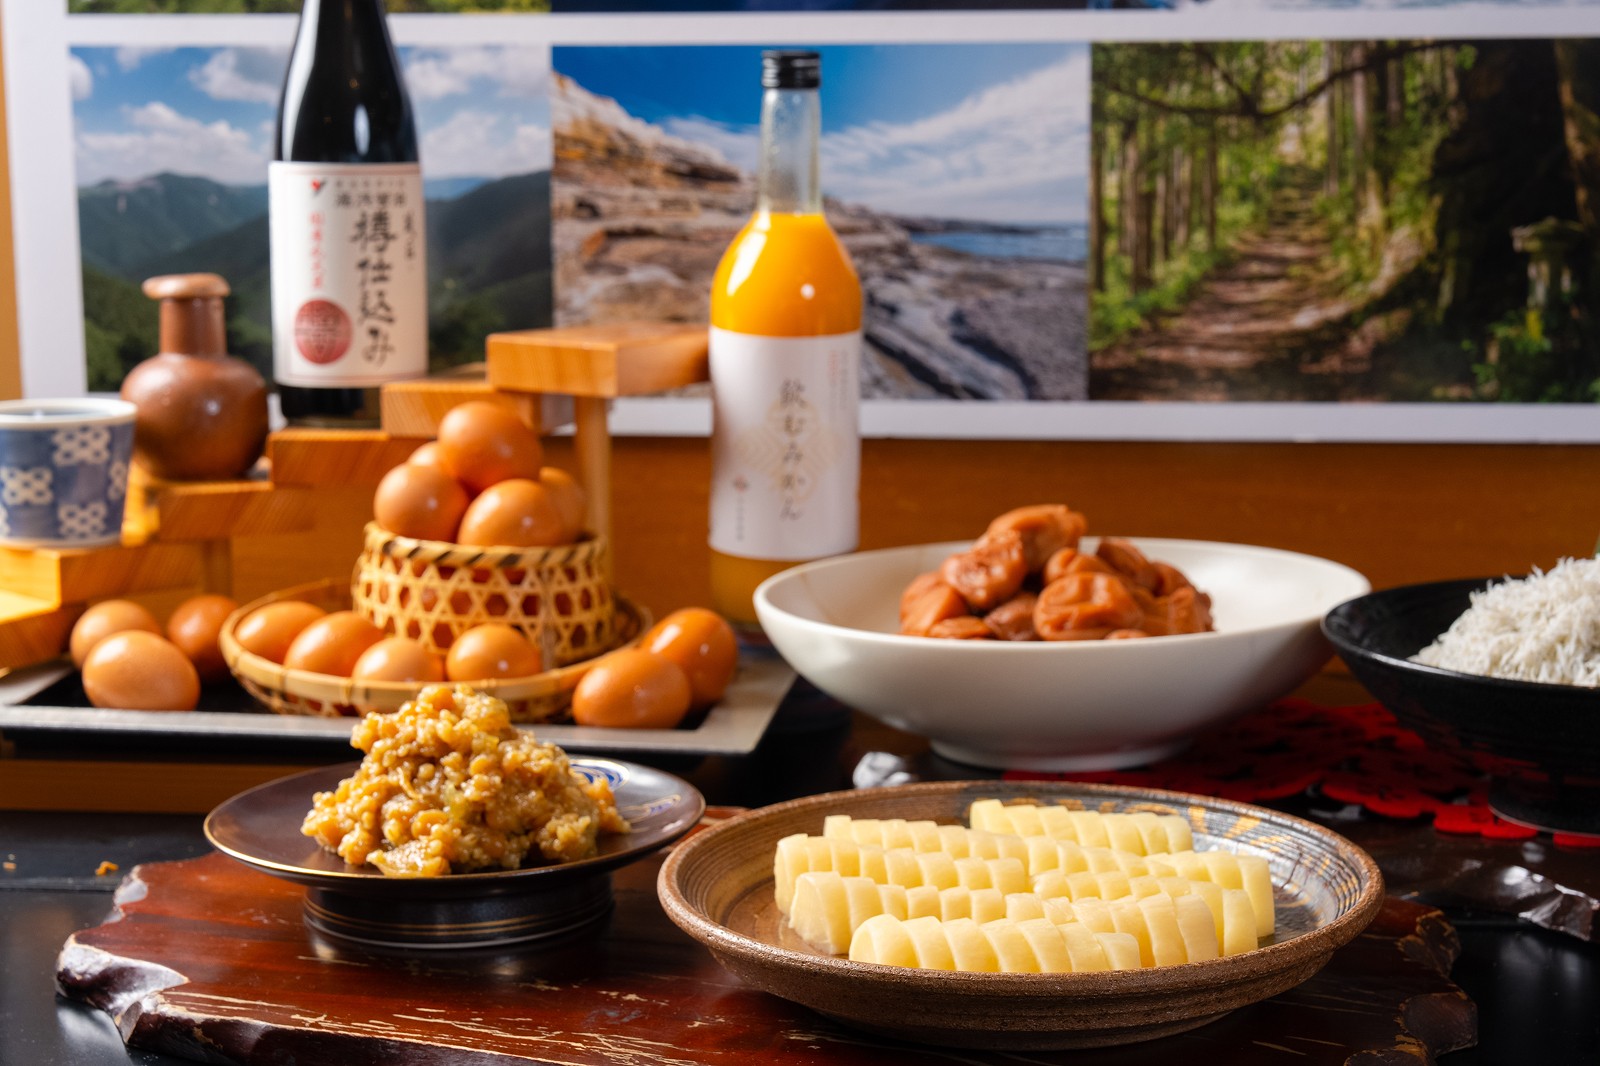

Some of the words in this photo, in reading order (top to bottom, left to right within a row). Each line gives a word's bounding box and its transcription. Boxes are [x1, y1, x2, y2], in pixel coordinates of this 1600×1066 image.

[349, 210, 396, 367] 樽仕込み
[779, 377, 807, 521] 飲むみかん
